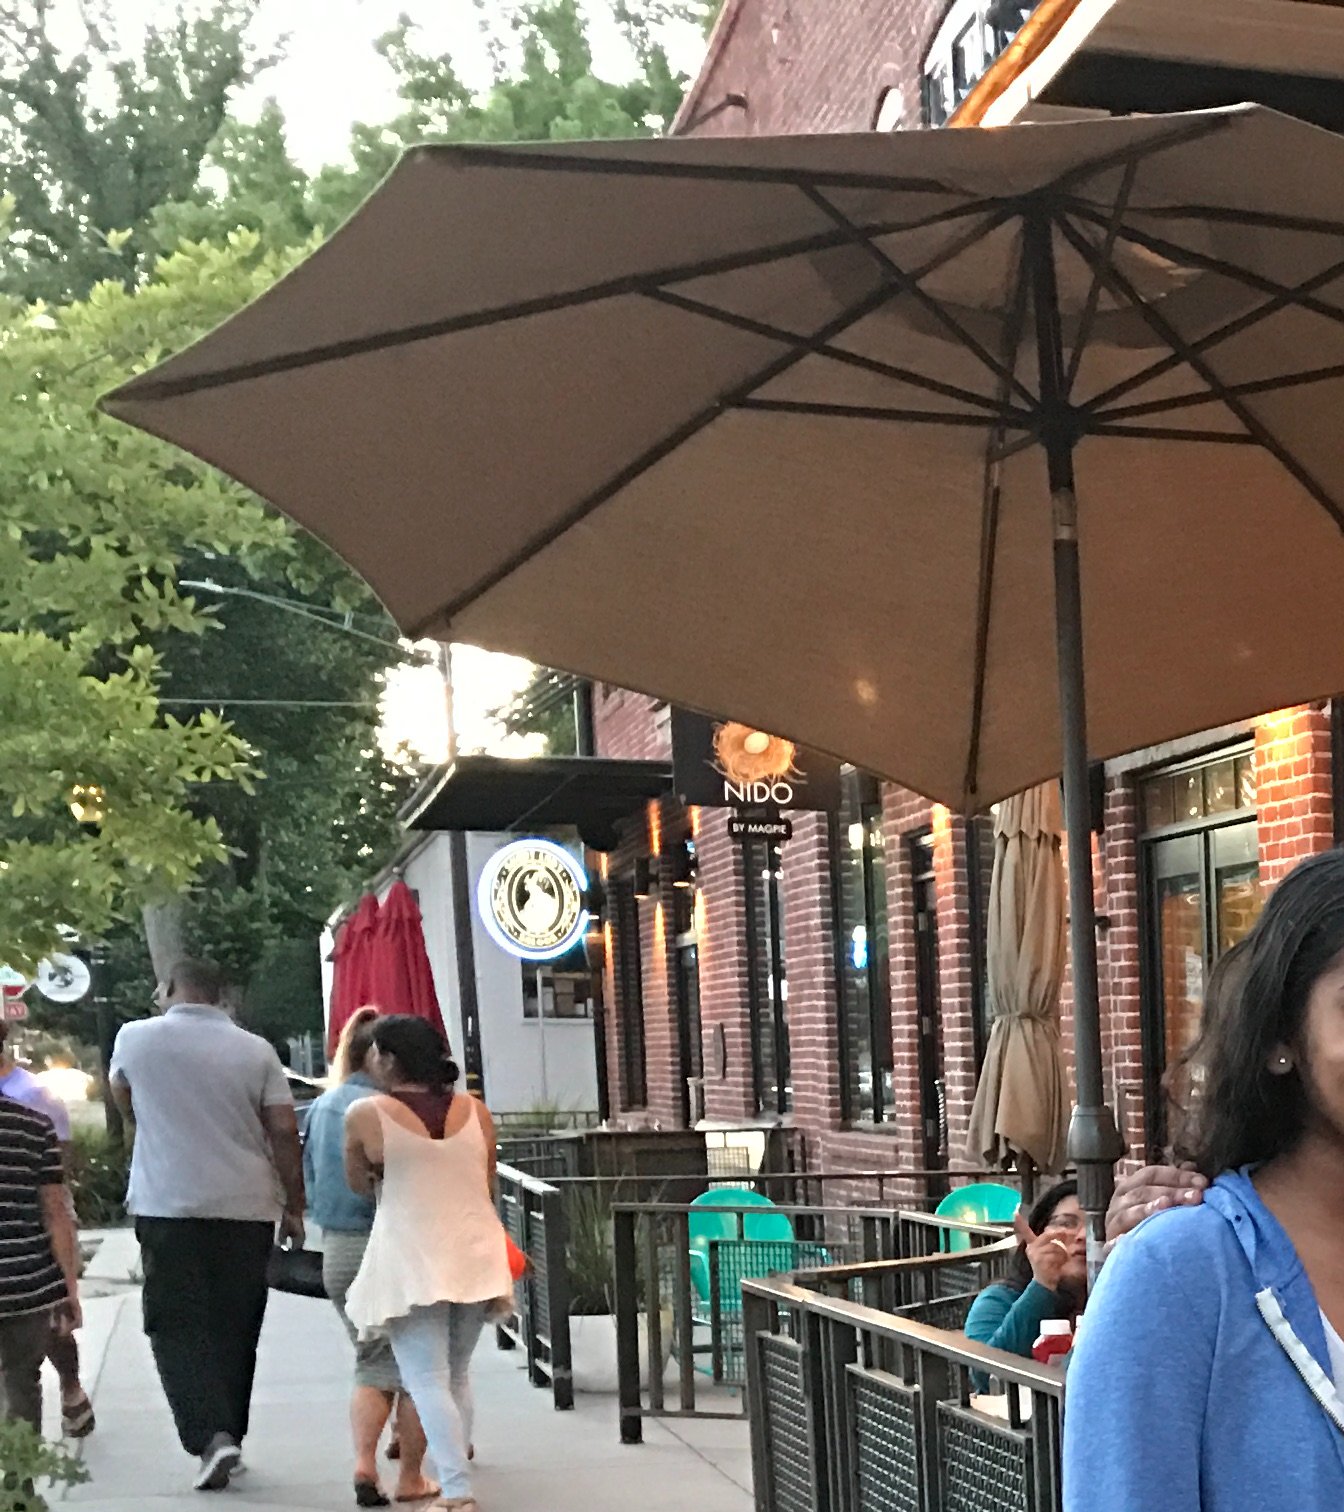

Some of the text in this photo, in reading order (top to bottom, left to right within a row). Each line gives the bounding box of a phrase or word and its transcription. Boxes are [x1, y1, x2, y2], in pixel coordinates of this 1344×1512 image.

[724, 780, 793, 804] NIDO
[732, 823, 786, 834] BY MAGPIE
